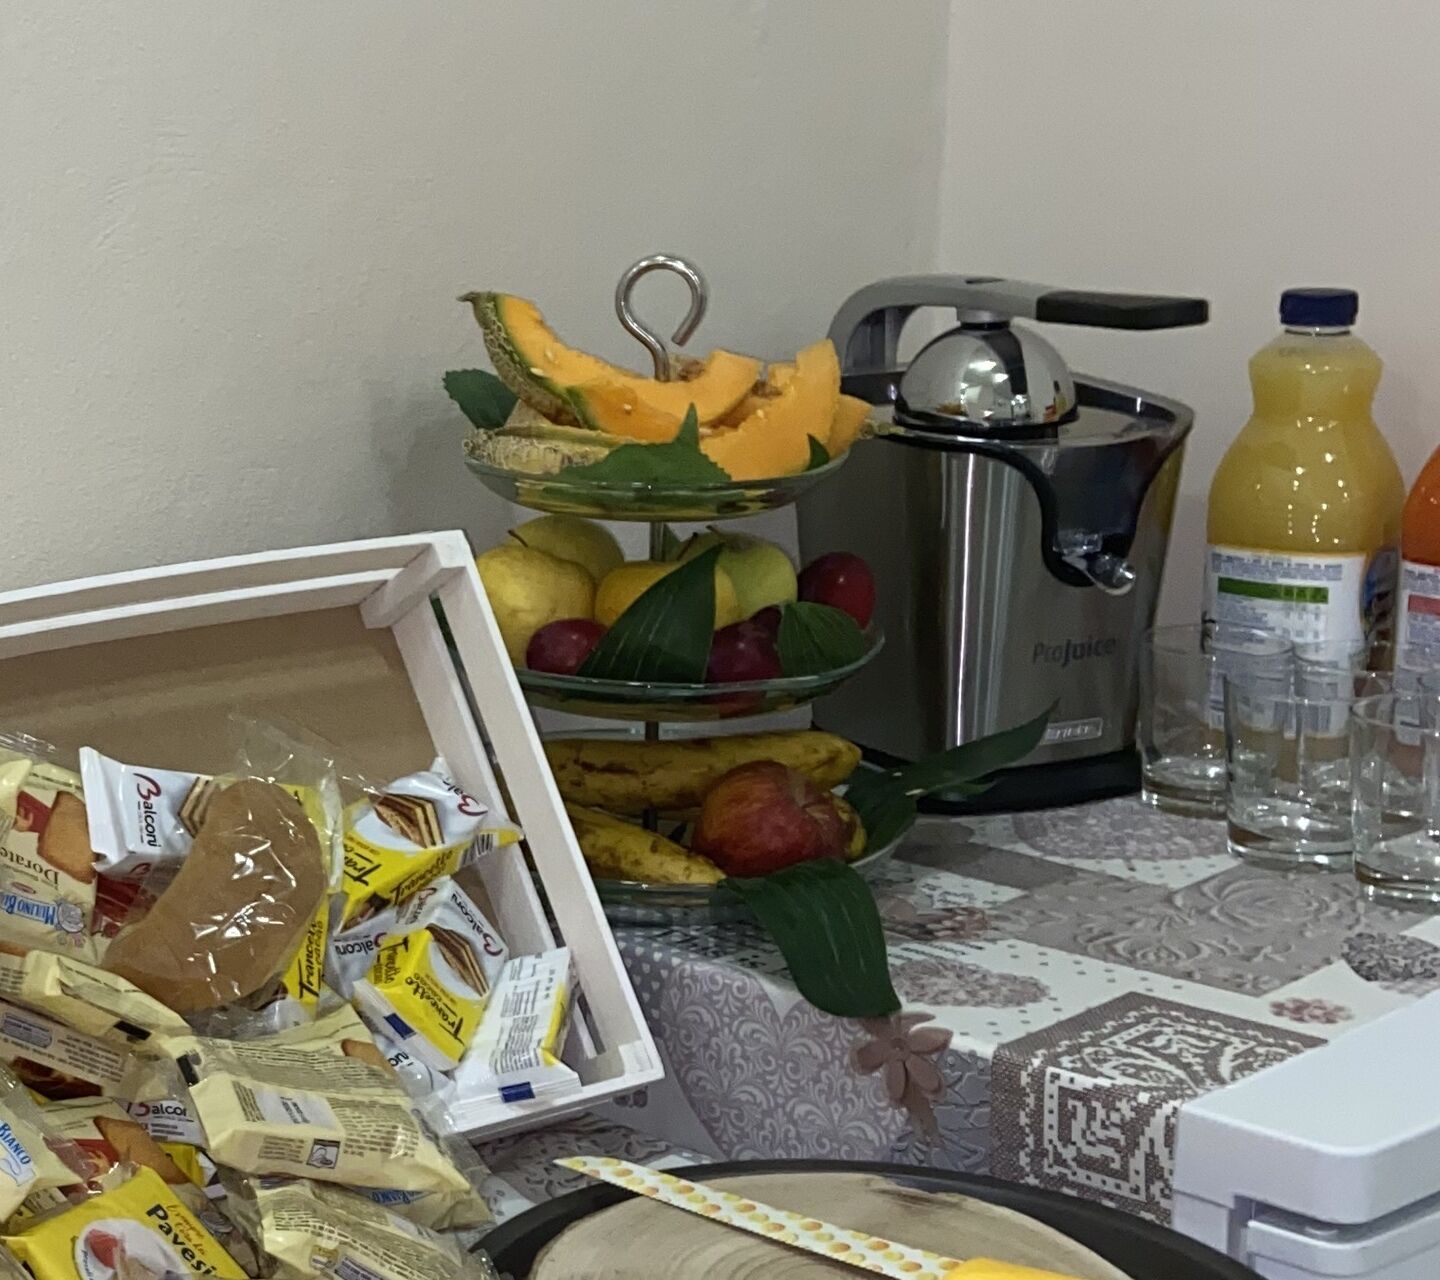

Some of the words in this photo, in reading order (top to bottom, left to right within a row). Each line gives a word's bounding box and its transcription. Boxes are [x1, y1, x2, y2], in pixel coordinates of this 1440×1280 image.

[1032, 637, 1117, 668] ProJuice
[133, 772, 162, 848] Balconi
[0, 846, 60, 886] Dorate
[450, 892, 504, 957] Balconi
[405, 975, 465, 1045] Trancetto
[146, 1203, 218, 1276] Pavesi
